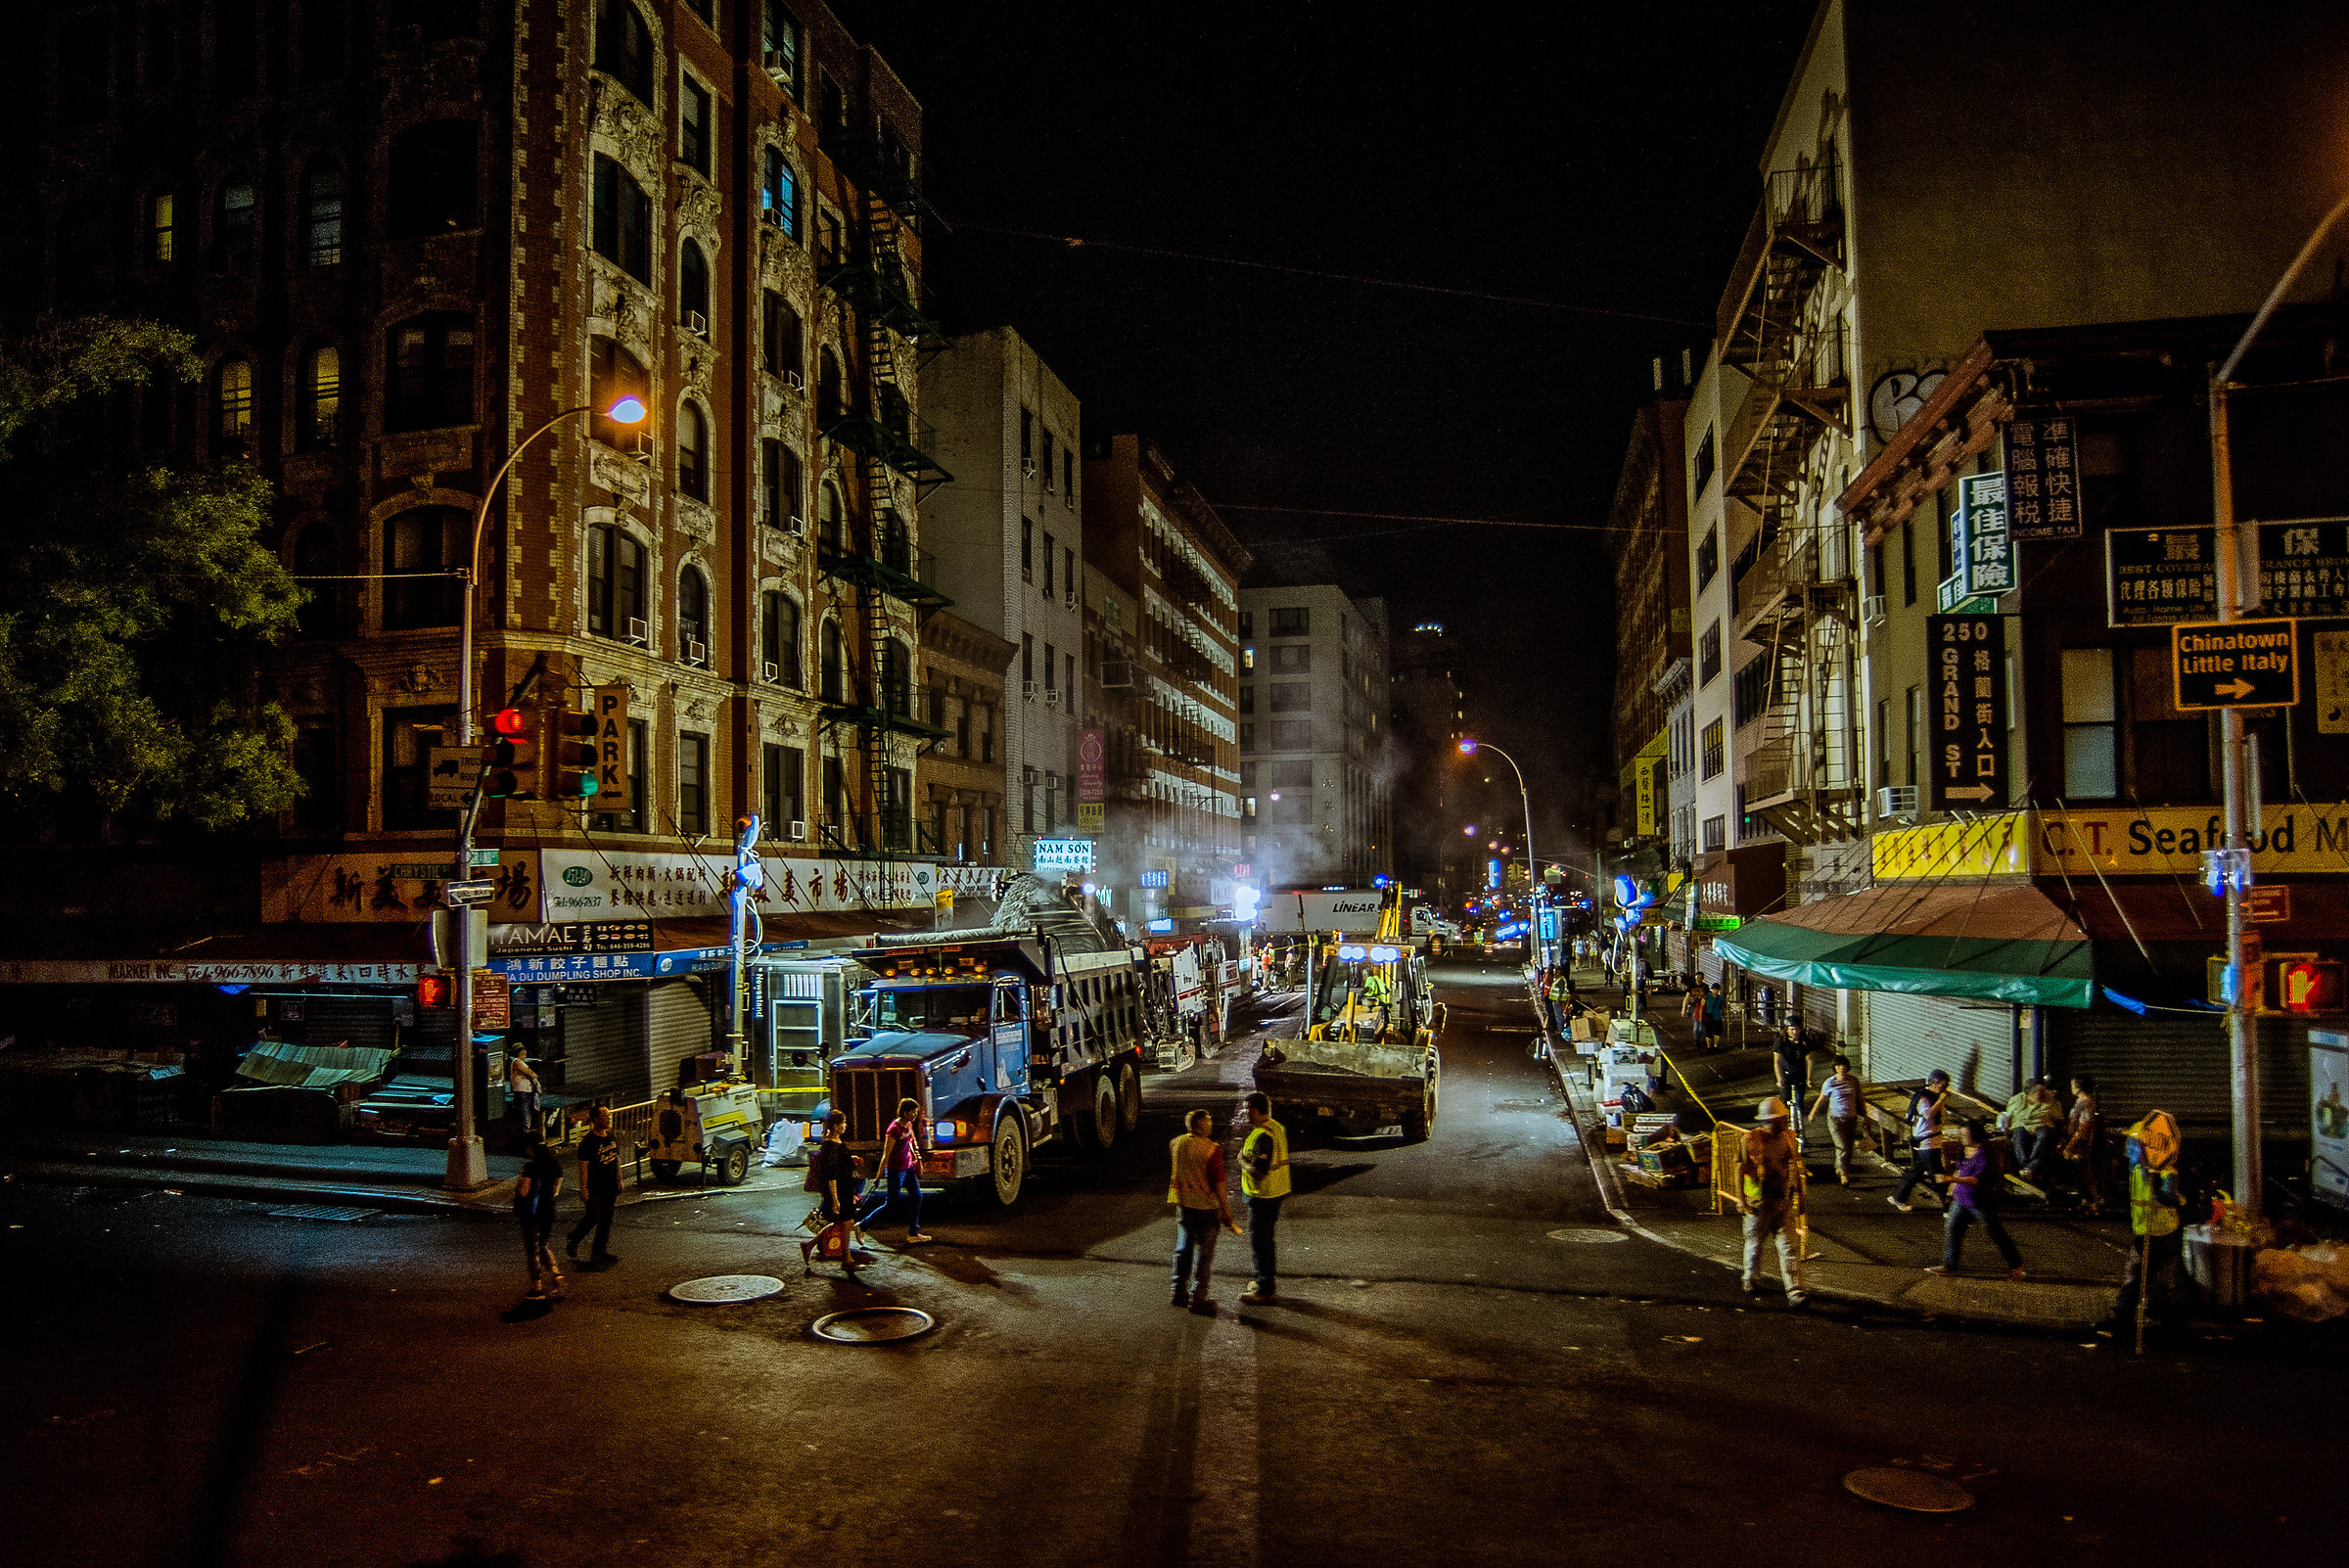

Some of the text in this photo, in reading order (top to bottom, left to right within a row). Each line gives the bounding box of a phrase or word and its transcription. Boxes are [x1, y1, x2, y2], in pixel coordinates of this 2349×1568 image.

[2056, 526, 2076, 535] TAX
[2118, 564, 2152, 575] BEST
[1942, 622, 1988, 642] 250
[2180, 632, 2290, 653] Chinatown
[2183, 651, 2288, 674] Little Italy
[1941, 647, 1961, 778] GRAND ST
[601, 695, 620, 785] PARK
[461, 757, 482, 766] TRUC
[2042, 821, 2074, 856] C.
[2084, 821, 2113, 856] T.
[1038, 844, 1063, 853] NAM
[109, 963, 176, 979] MARKET INC.
[519, 972, 534, 982] DU
[536, 970, 590, 981] DUMPLING
[592, 968, 622, 979] SHOP
[622, 967, 643, 978] INC.
